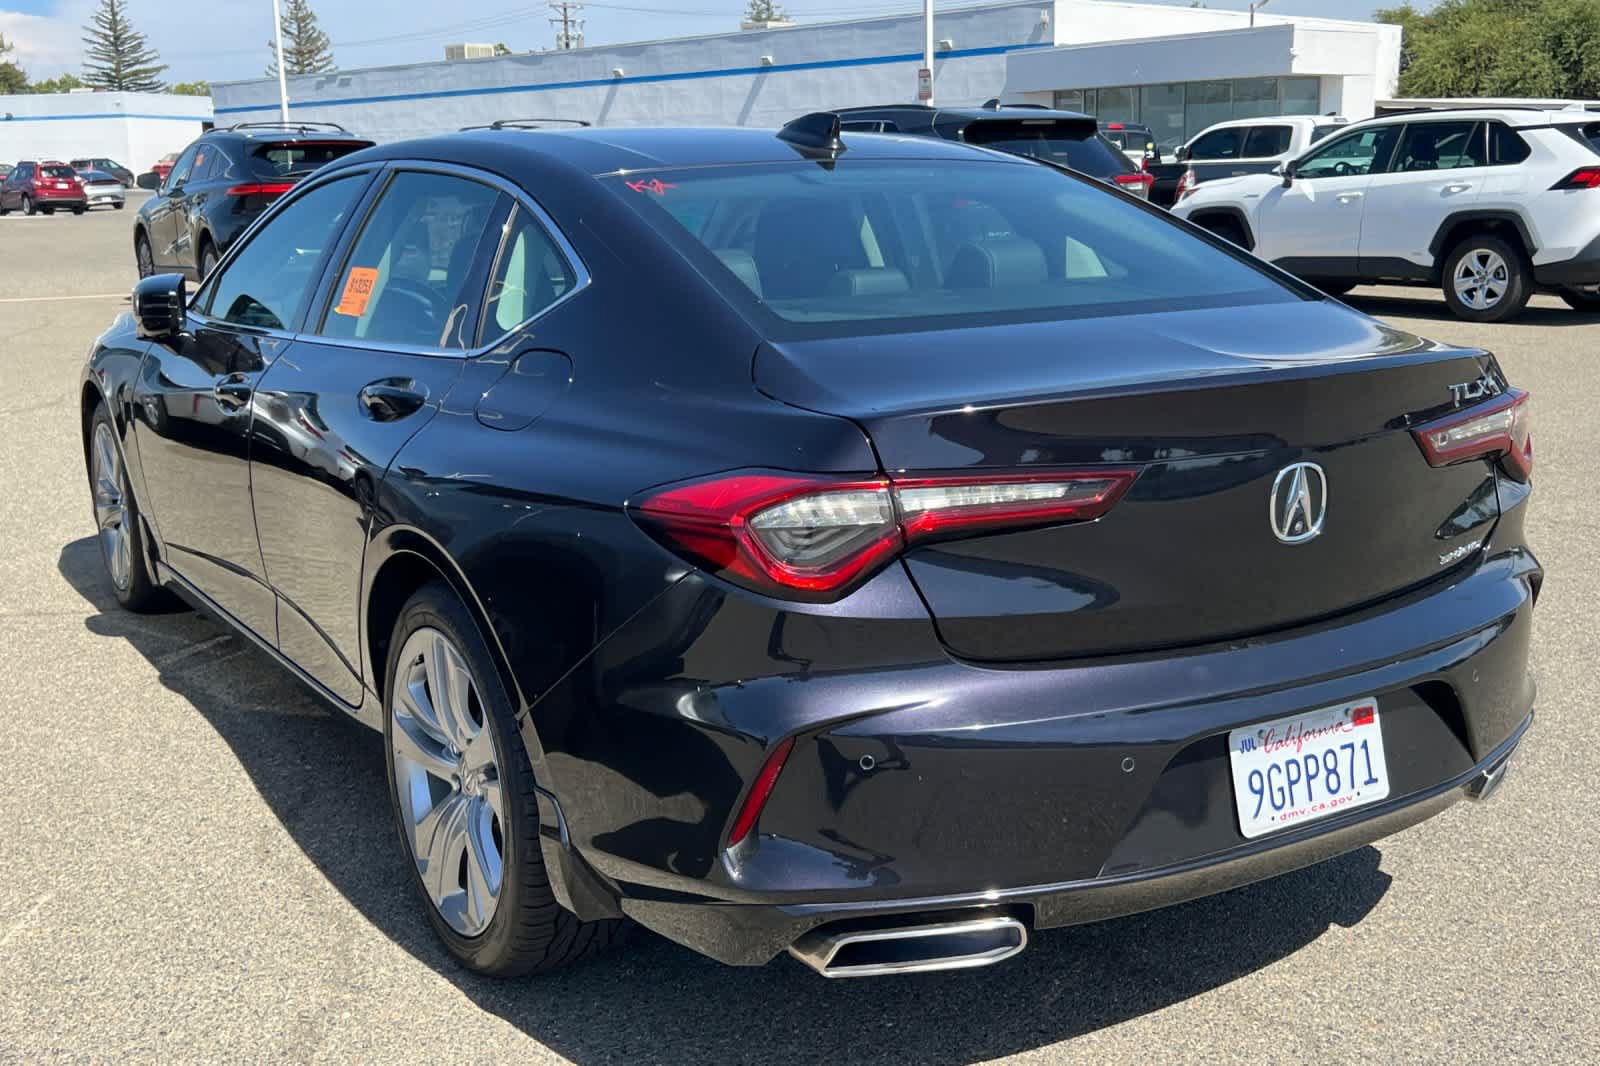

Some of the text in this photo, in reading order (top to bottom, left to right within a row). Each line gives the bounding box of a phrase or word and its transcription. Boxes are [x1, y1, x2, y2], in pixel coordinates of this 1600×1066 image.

[1239, 737, 1257, 754] JUL
[1264, 721, 1353, 754] California
[1248, 738, 1379, 820] 9GPP871
[1279, 794, 1354, 822] dmv.ca.gov
